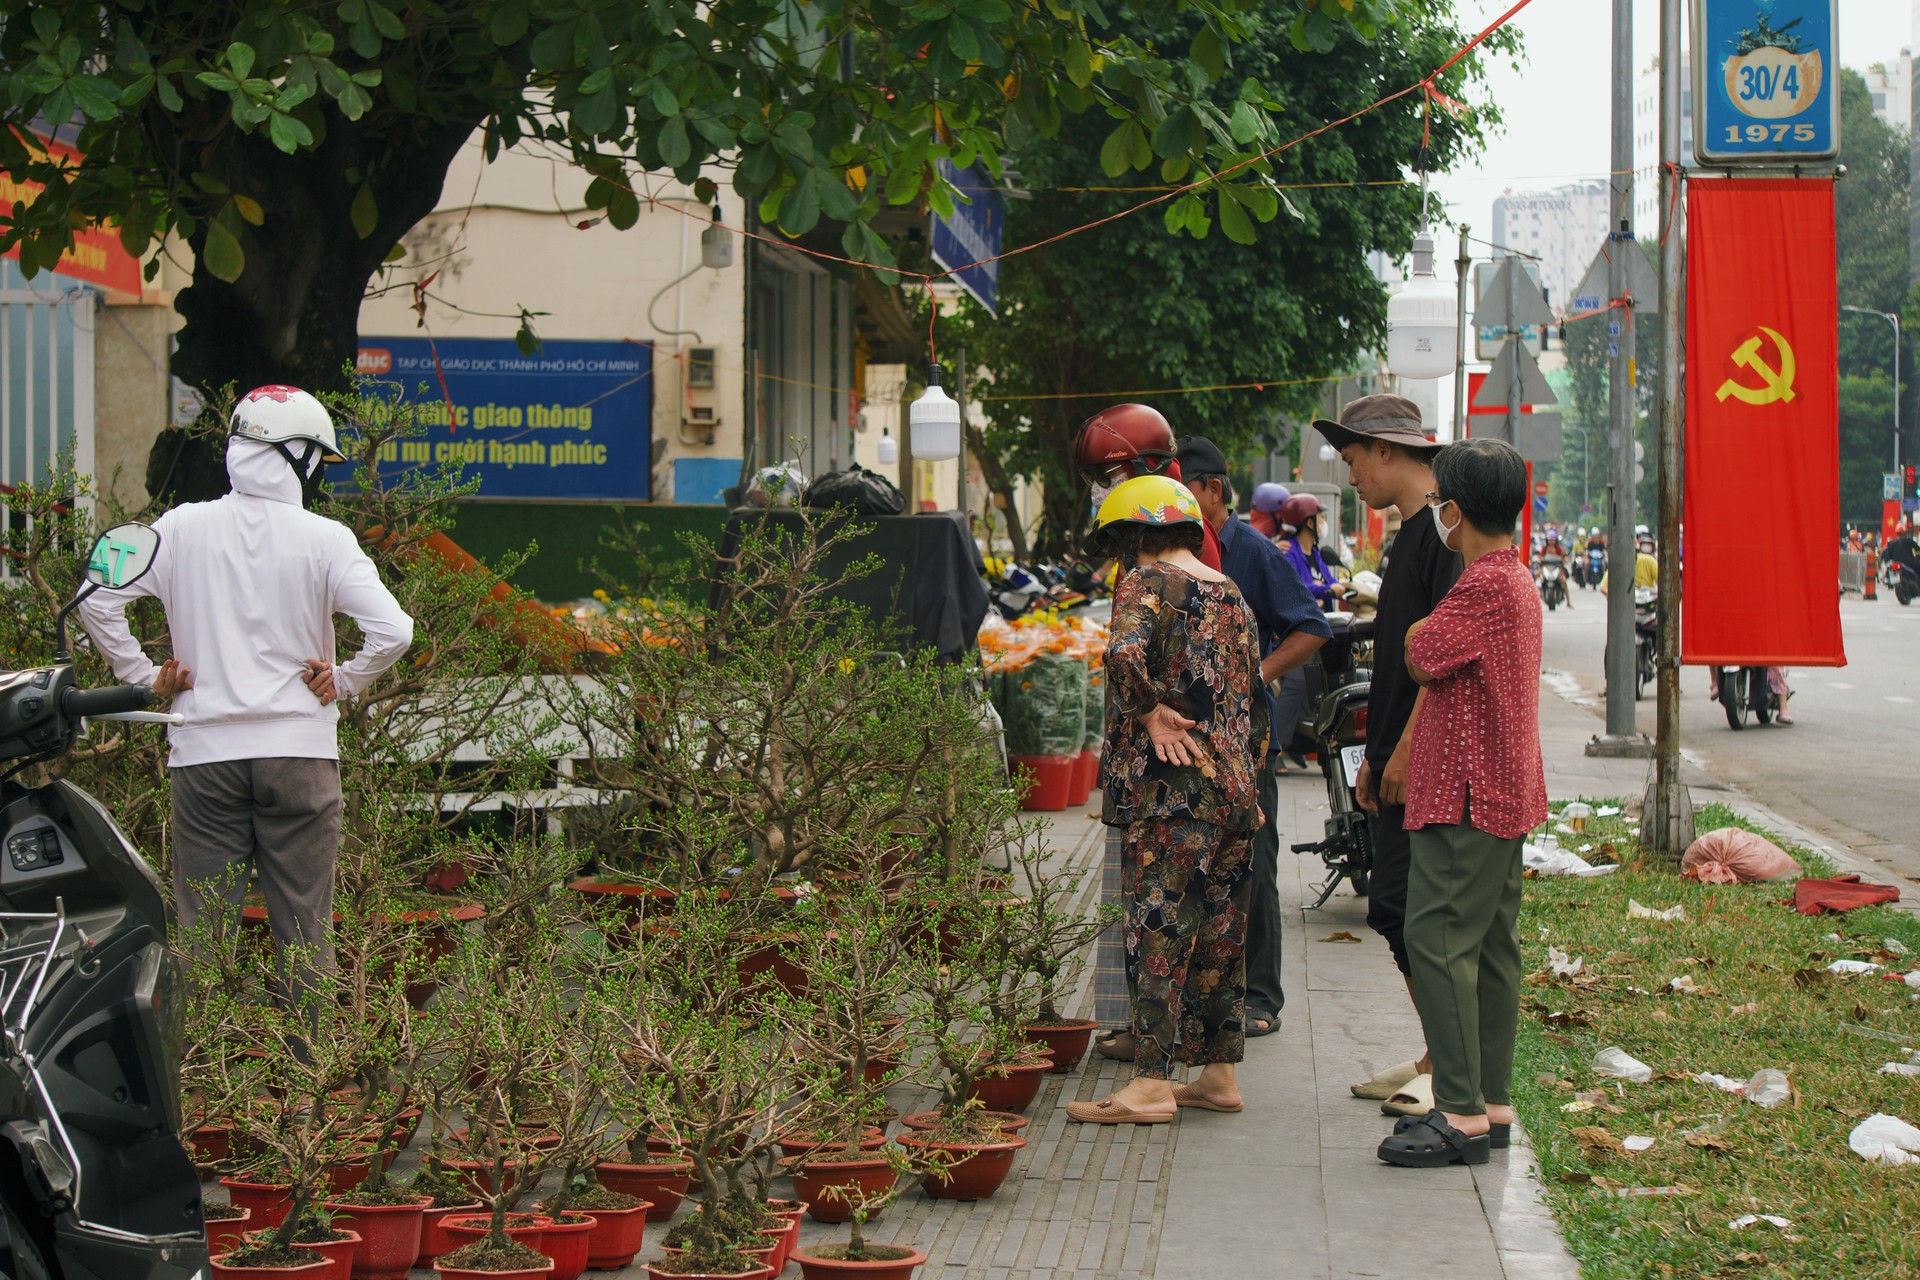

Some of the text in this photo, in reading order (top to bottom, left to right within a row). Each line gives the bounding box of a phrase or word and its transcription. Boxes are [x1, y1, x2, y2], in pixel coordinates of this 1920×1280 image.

[1738, 64, 1799, 101] 30/4
[1725, 123, 1816, 143] 1975
[419, 356, 438, 370] CH
[440, 356, 471, 370] GIÁO
[471, 359, 497, 372] DỤC
[499, 357, 539, 371] THÀNH
[540, 358, 565, 372] PHỐ
[566, 358, 585, 372] HỒ
[586, 358, 606, 372] CHÍ
[607, 359, 639, 371] MINH
[473, 402, 522, 430] giao
[527, 403, 592, 431] thông
[402, 441, 430, 468] nụ
[435, 437, 485, 464] cười
[489, 439, 546, 470] hạnh
[550, 439, 607, 468] phúc
